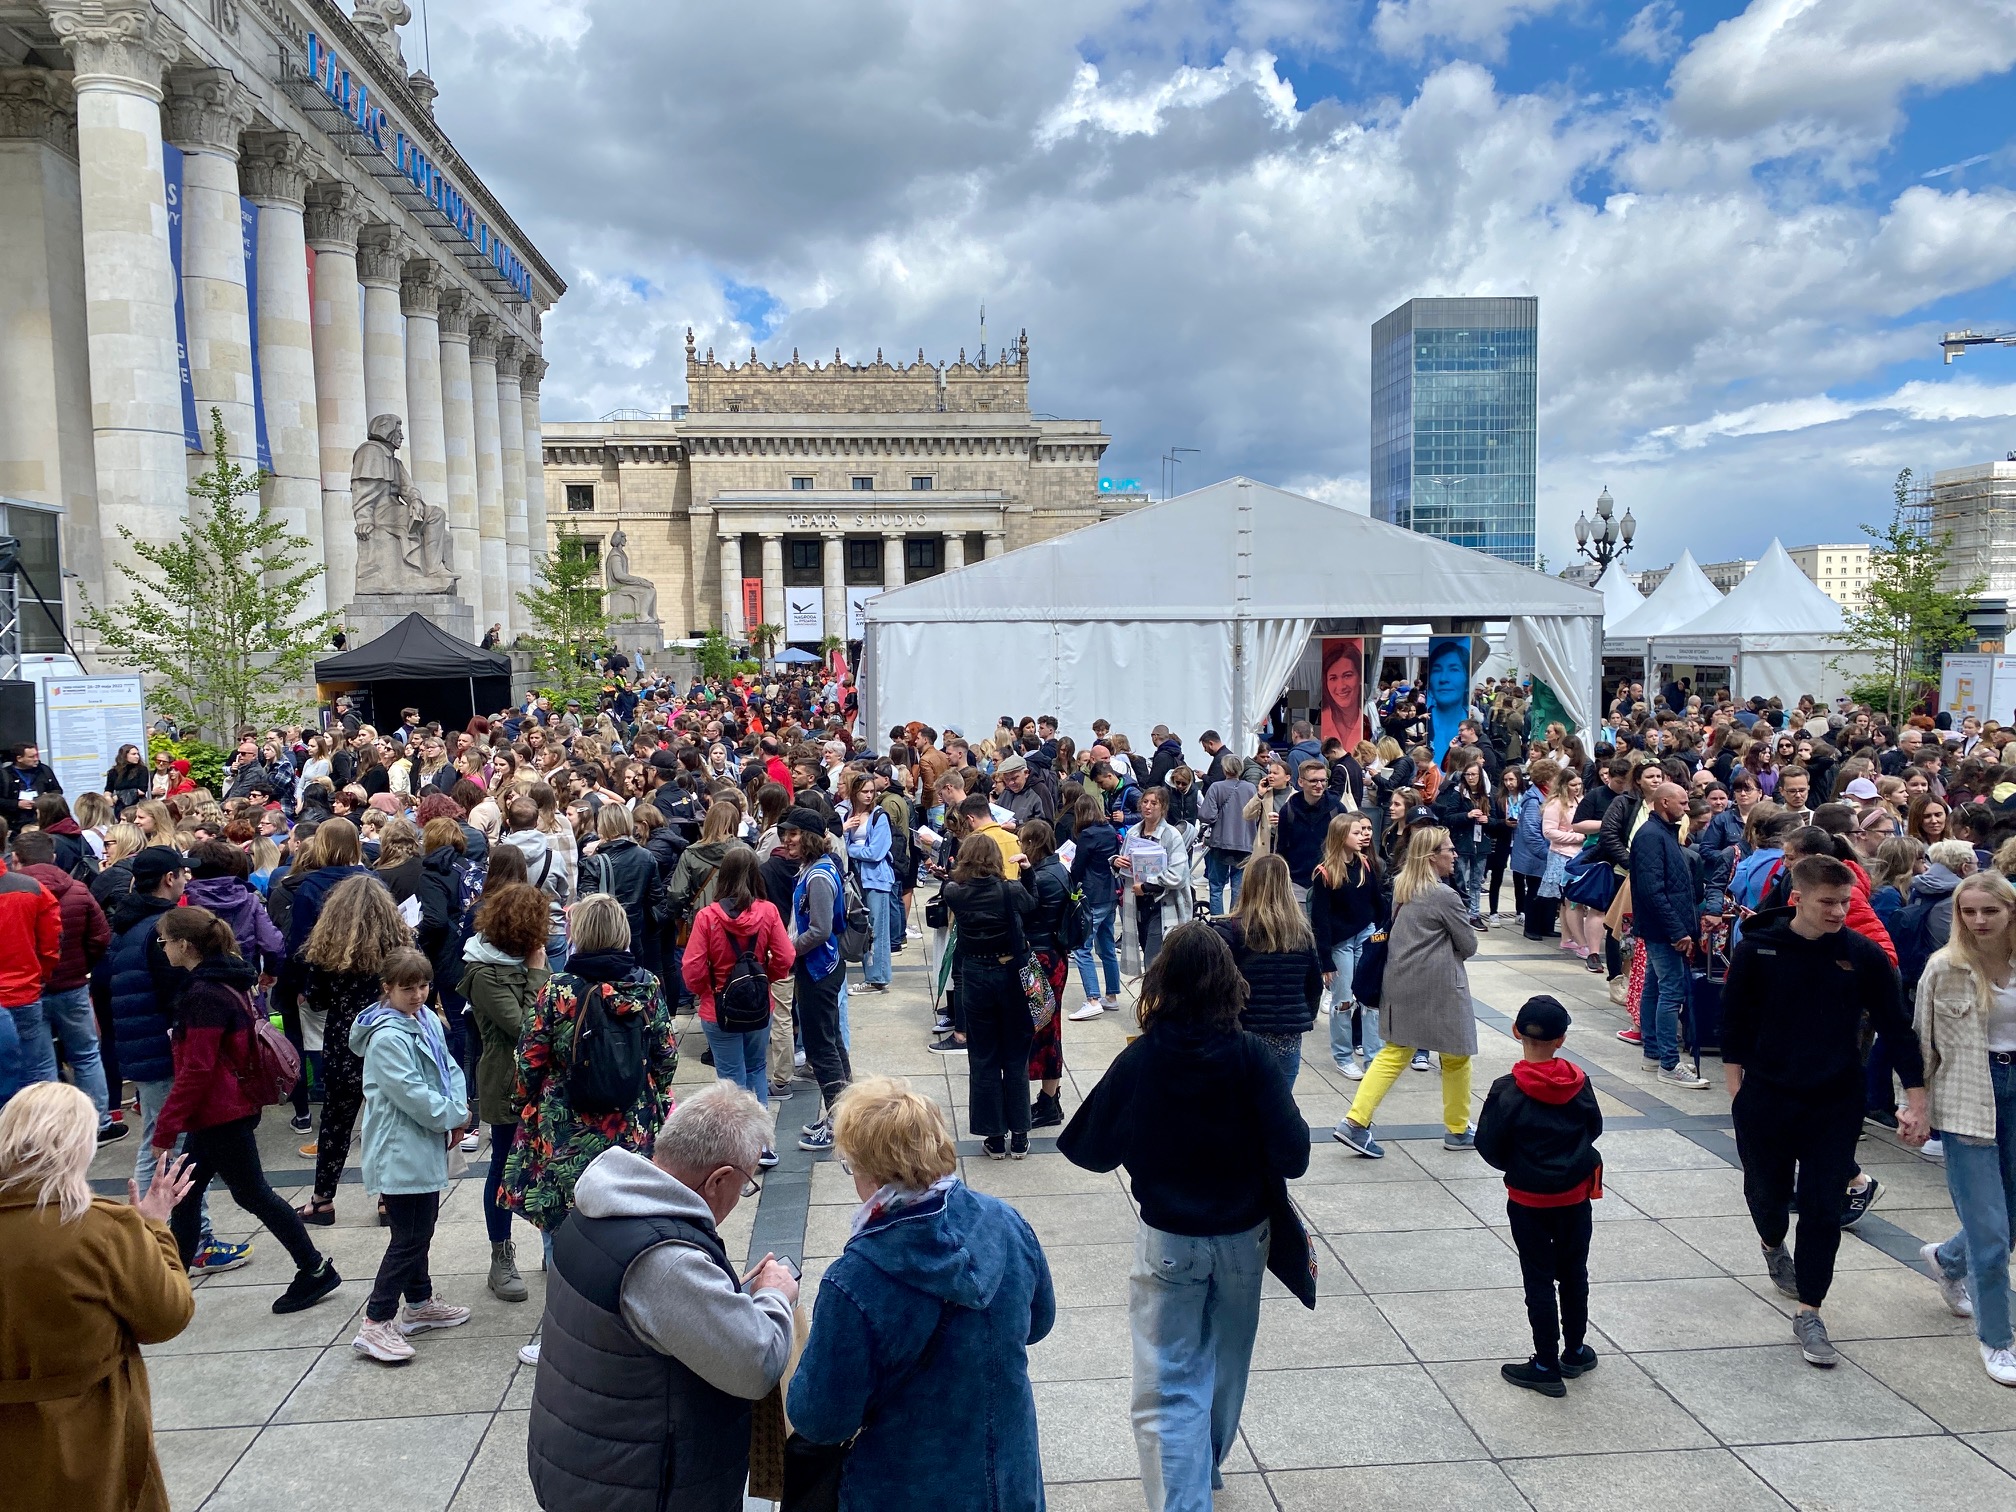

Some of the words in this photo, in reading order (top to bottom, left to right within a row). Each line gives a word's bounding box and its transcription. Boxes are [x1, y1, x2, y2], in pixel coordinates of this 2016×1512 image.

[167, 183, 178, 206] S
[396, 131, 476, 242] KULTURY
[480, 222, 488, 256] I
[788, 514, 839, 528] TEATR
[856, 514, 927, 527] STUDIO
[1850, 1198, 1865, 1210] N
